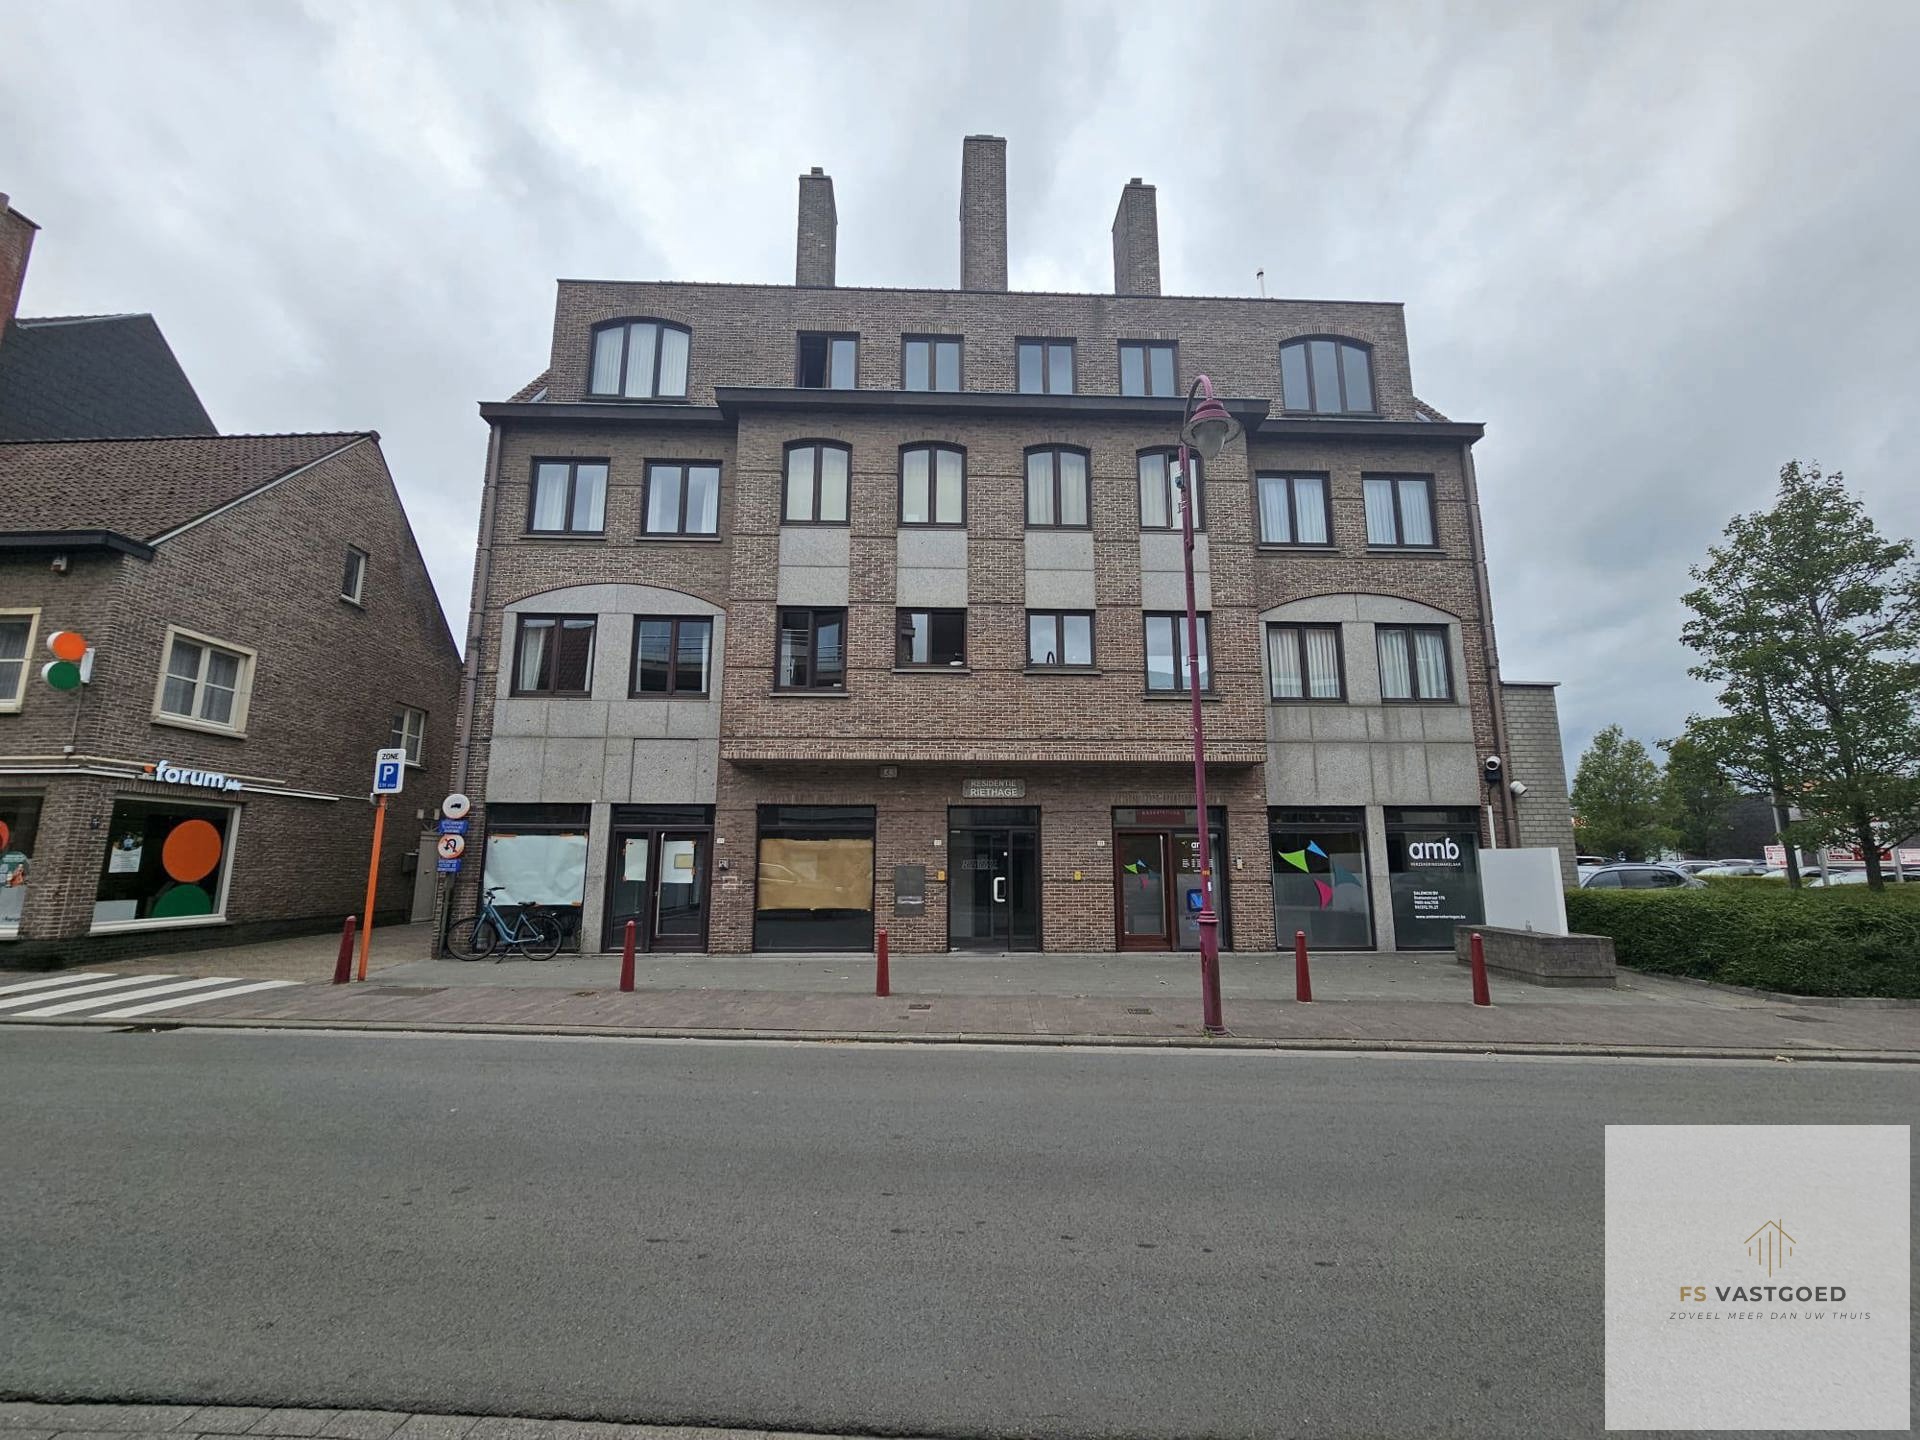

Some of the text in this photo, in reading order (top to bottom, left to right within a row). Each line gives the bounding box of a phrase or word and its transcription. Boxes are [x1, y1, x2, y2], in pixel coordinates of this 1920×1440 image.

[381, 752, 399, 760] ZONE
[156, 759, 224, 789] forum
[383, 765, 395, 782] P
[970, 788, 1018, 797] RIETHAGE
[1408, 837, 1460, 860] amb
